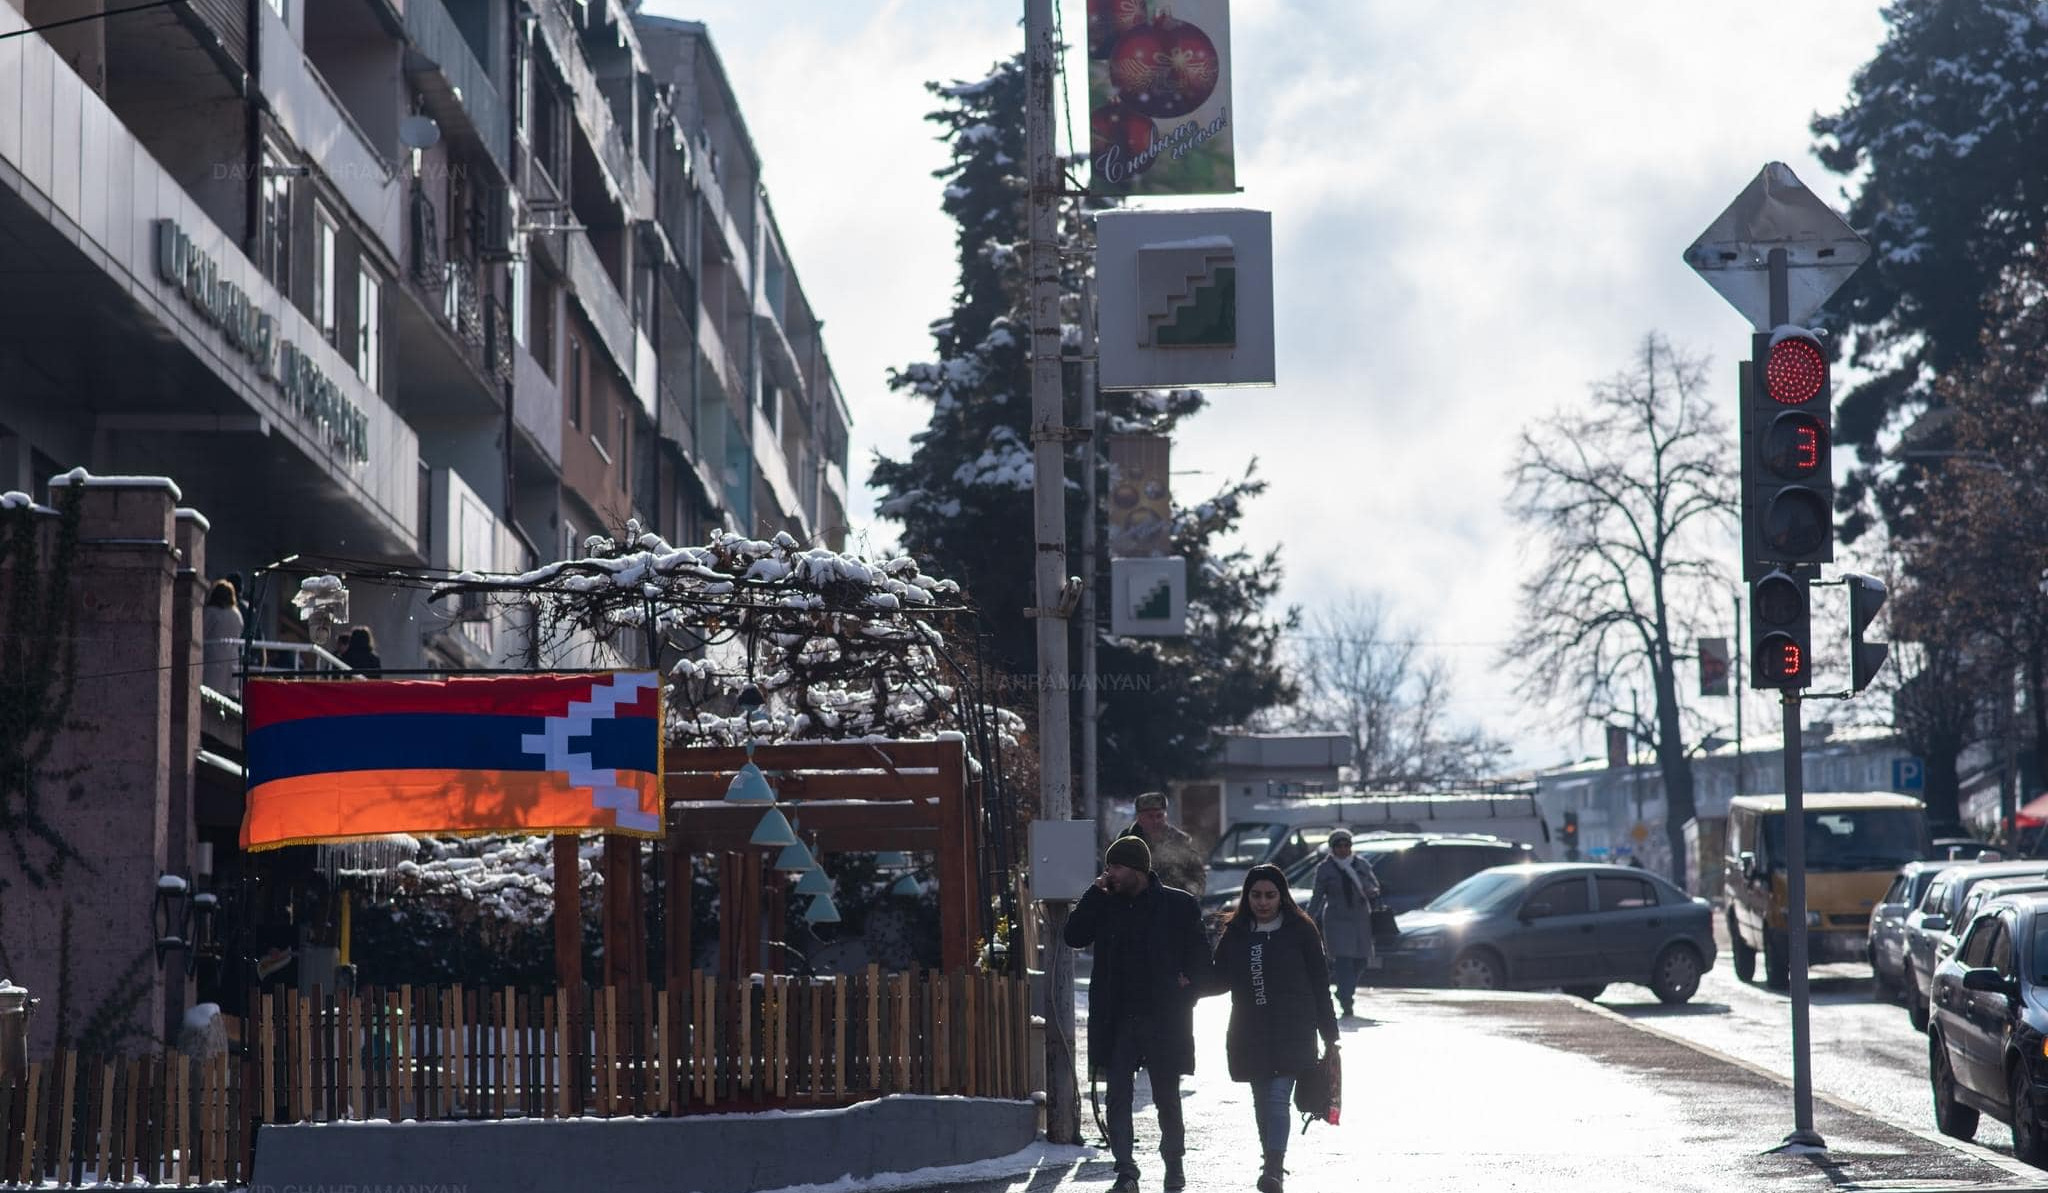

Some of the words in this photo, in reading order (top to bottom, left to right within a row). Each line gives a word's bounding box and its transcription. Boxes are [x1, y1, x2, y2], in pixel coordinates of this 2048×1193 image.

[1796, 427, 1816, 468] 3
[1784, 645, 1800, 675] 3
[1900, 763, 1919, 788] P
[1248, 942, 1269, 1007] BALENCIAGA
